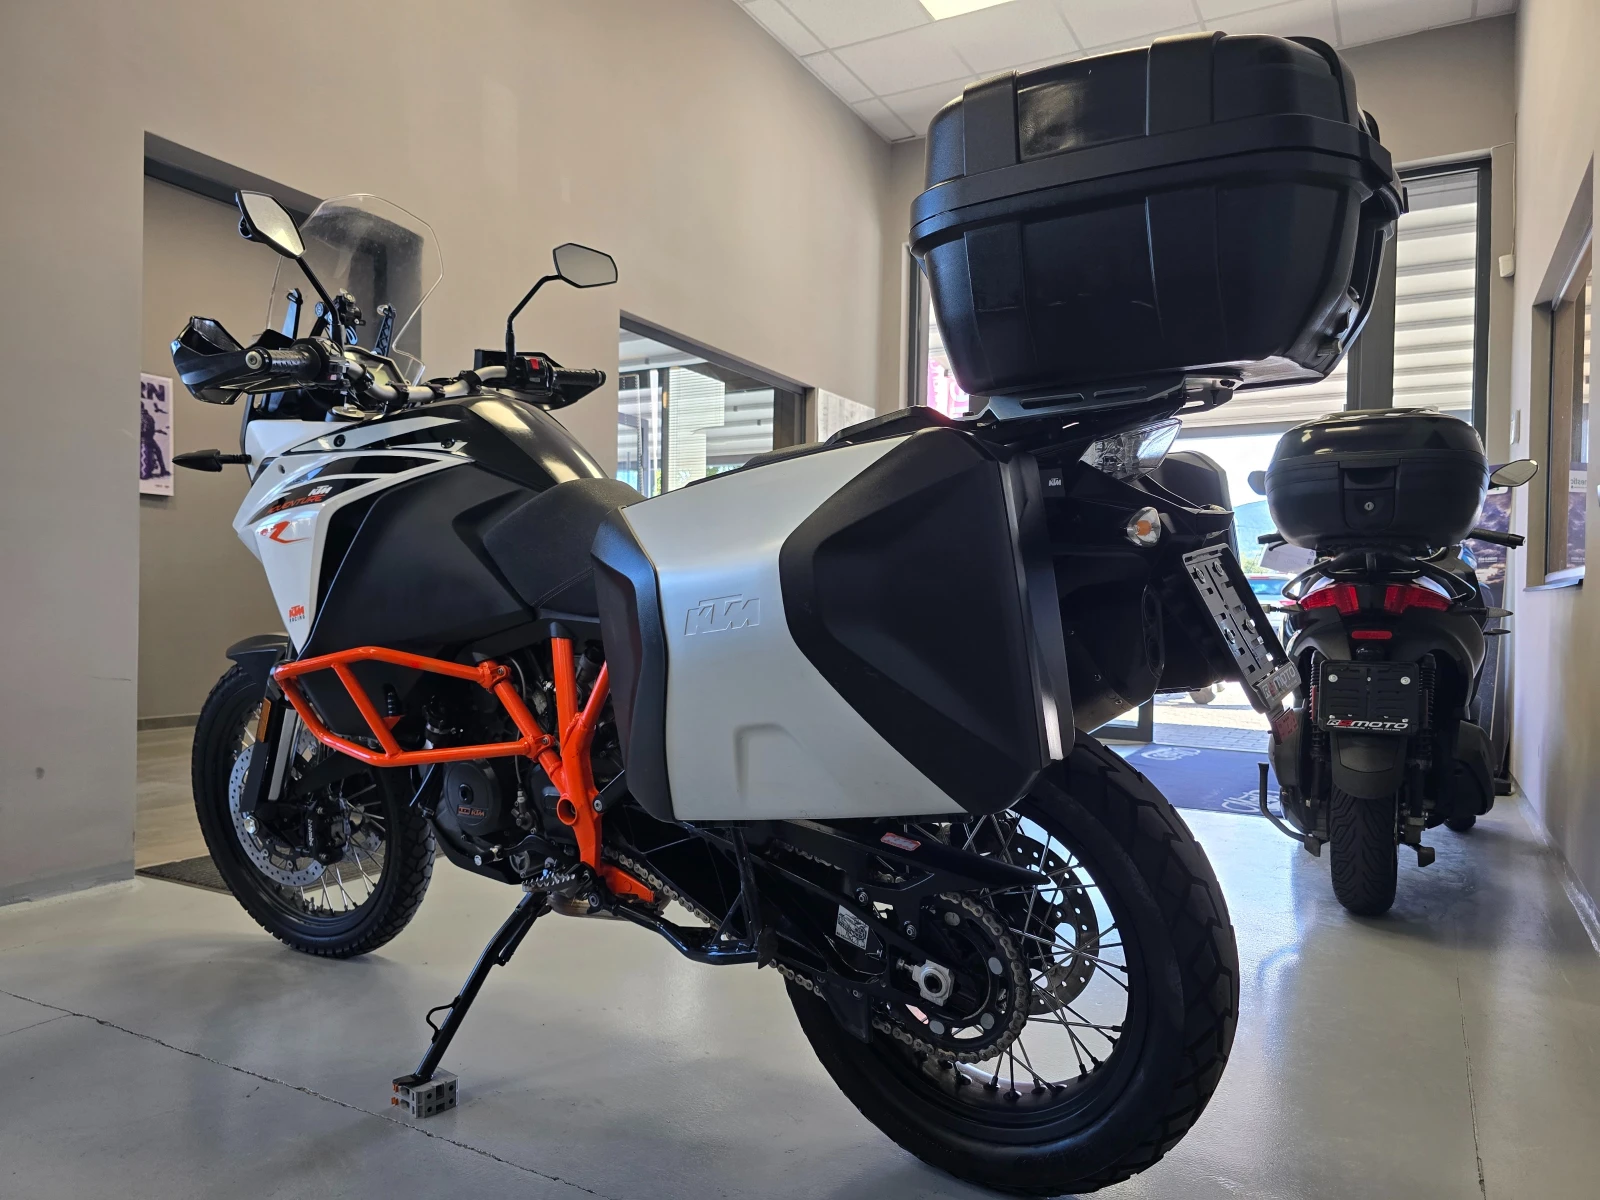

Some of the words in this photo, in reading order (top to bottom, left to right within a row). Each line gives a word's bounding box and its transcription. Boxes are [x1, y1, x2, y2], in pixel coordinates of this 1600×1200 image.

[1048, 477, 1062, 487] KTM
[307, 485, 333, 496] KTM
[288, 605, 305, 618] KTM
[684, 593, 760, 636] KTM
[471, 809, 485, 817] KTM
